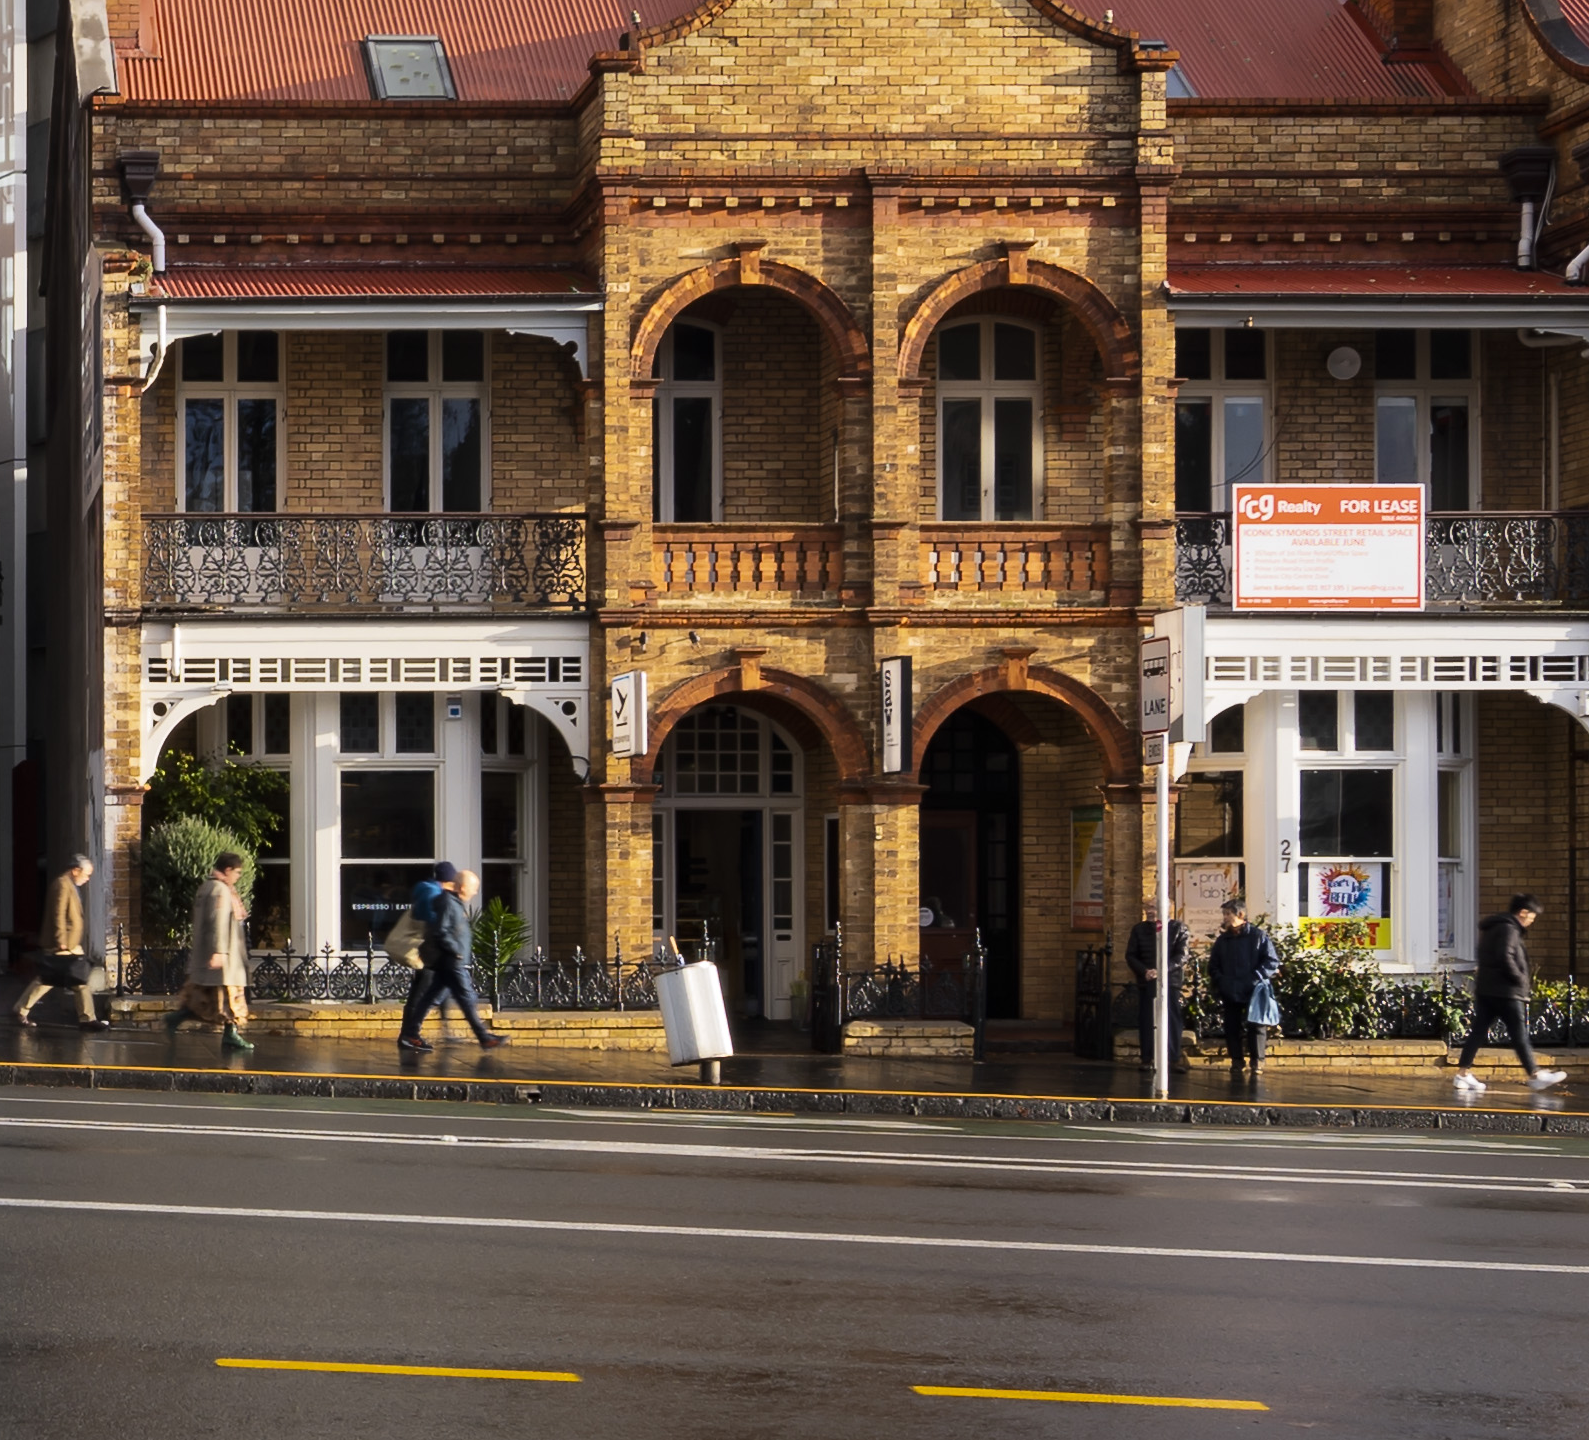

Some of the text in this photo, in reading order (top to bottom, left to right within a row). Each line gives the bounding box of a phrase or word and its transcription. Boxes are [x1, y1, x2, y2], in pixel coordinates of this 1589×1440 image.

[1239, 494, 1322, 521] rcg Realty
[1340, 500, 1418, 513] FOR LEASE
[1244, 529, 1413, 537] ICONIC SYMONDS STREET RETAIL SPACE
[1291, 538, 1366, 546] AVAILABLE JUNE
[1144, 698, 1166, 716] LANE
[1280, 839, 1291, 873] 27
